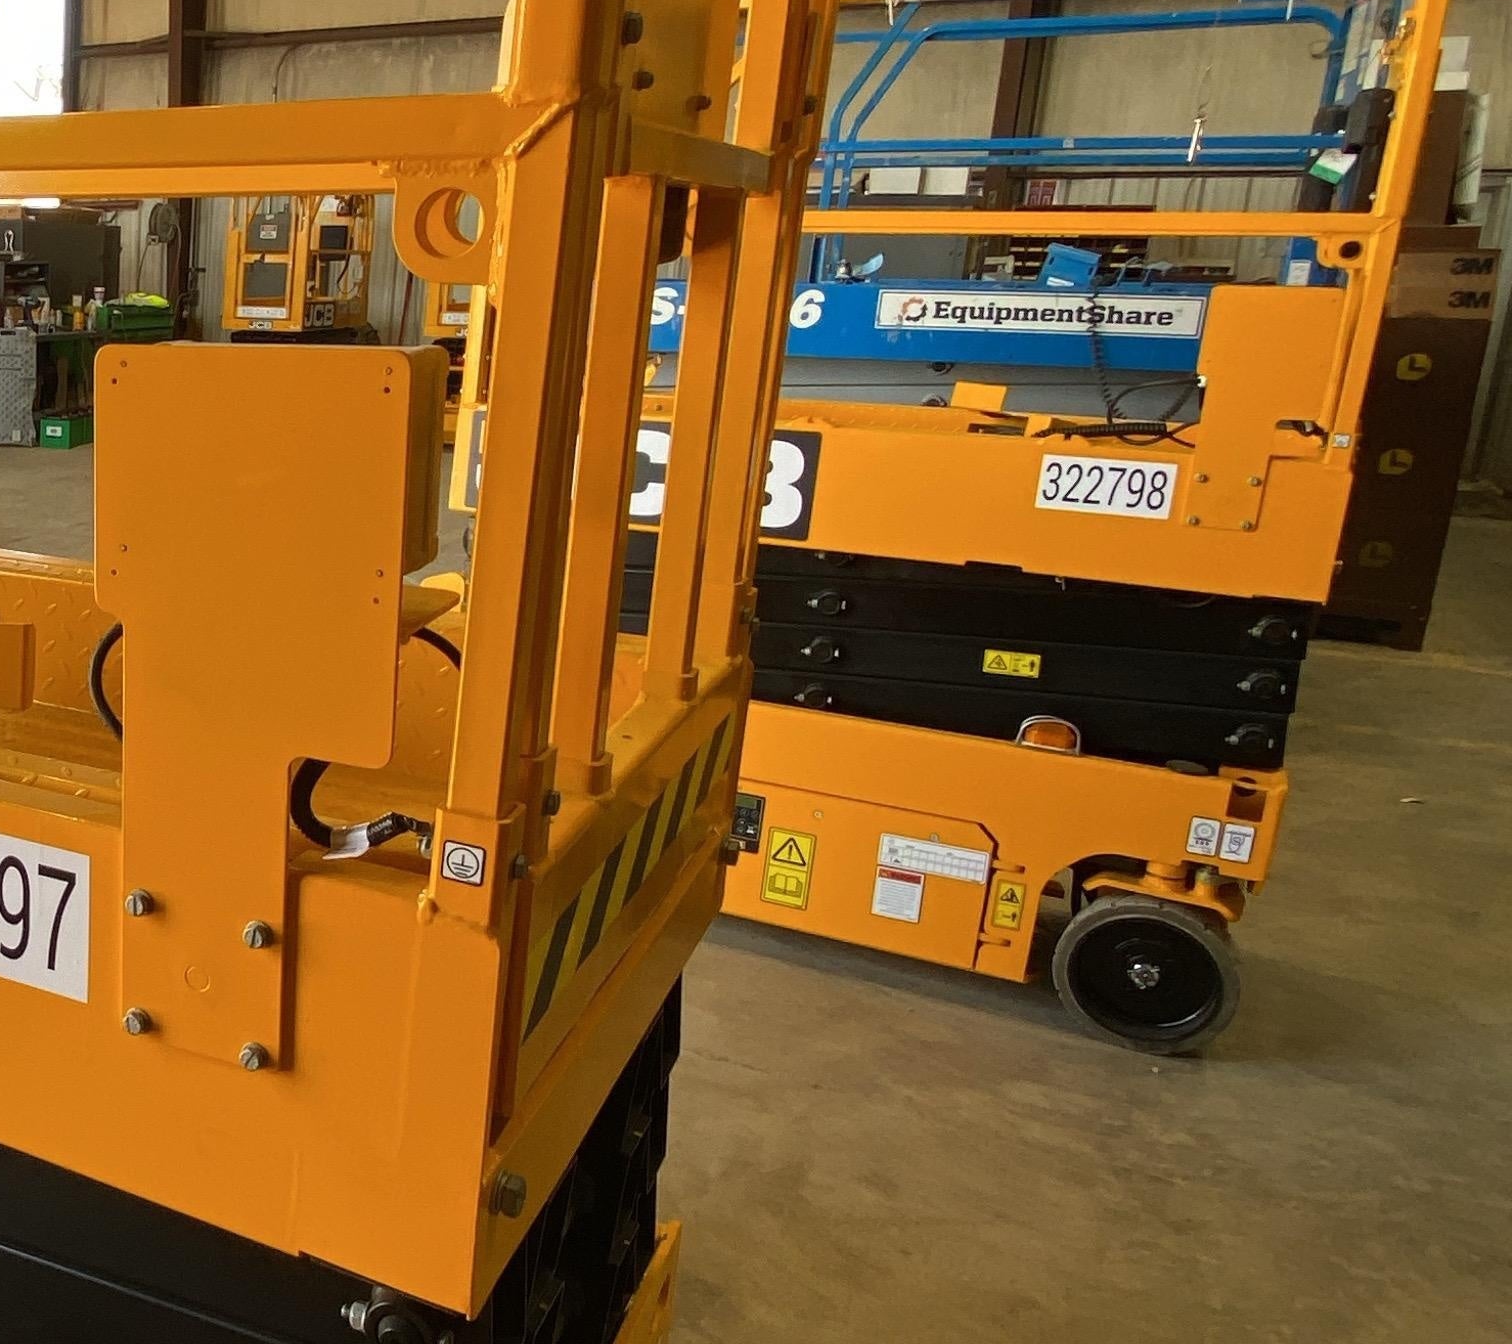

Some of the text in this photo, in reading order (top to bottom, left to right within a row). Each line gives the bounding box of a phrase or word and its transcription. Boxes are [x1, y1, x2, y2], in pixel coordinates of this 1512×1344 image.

[1447, 290, 1491, 309] 3M
[303, 303, 336, 328] JCB
[933, 300, 1175, 327] EquipmentShare
[1042, 462, 1169, 510] 322798
